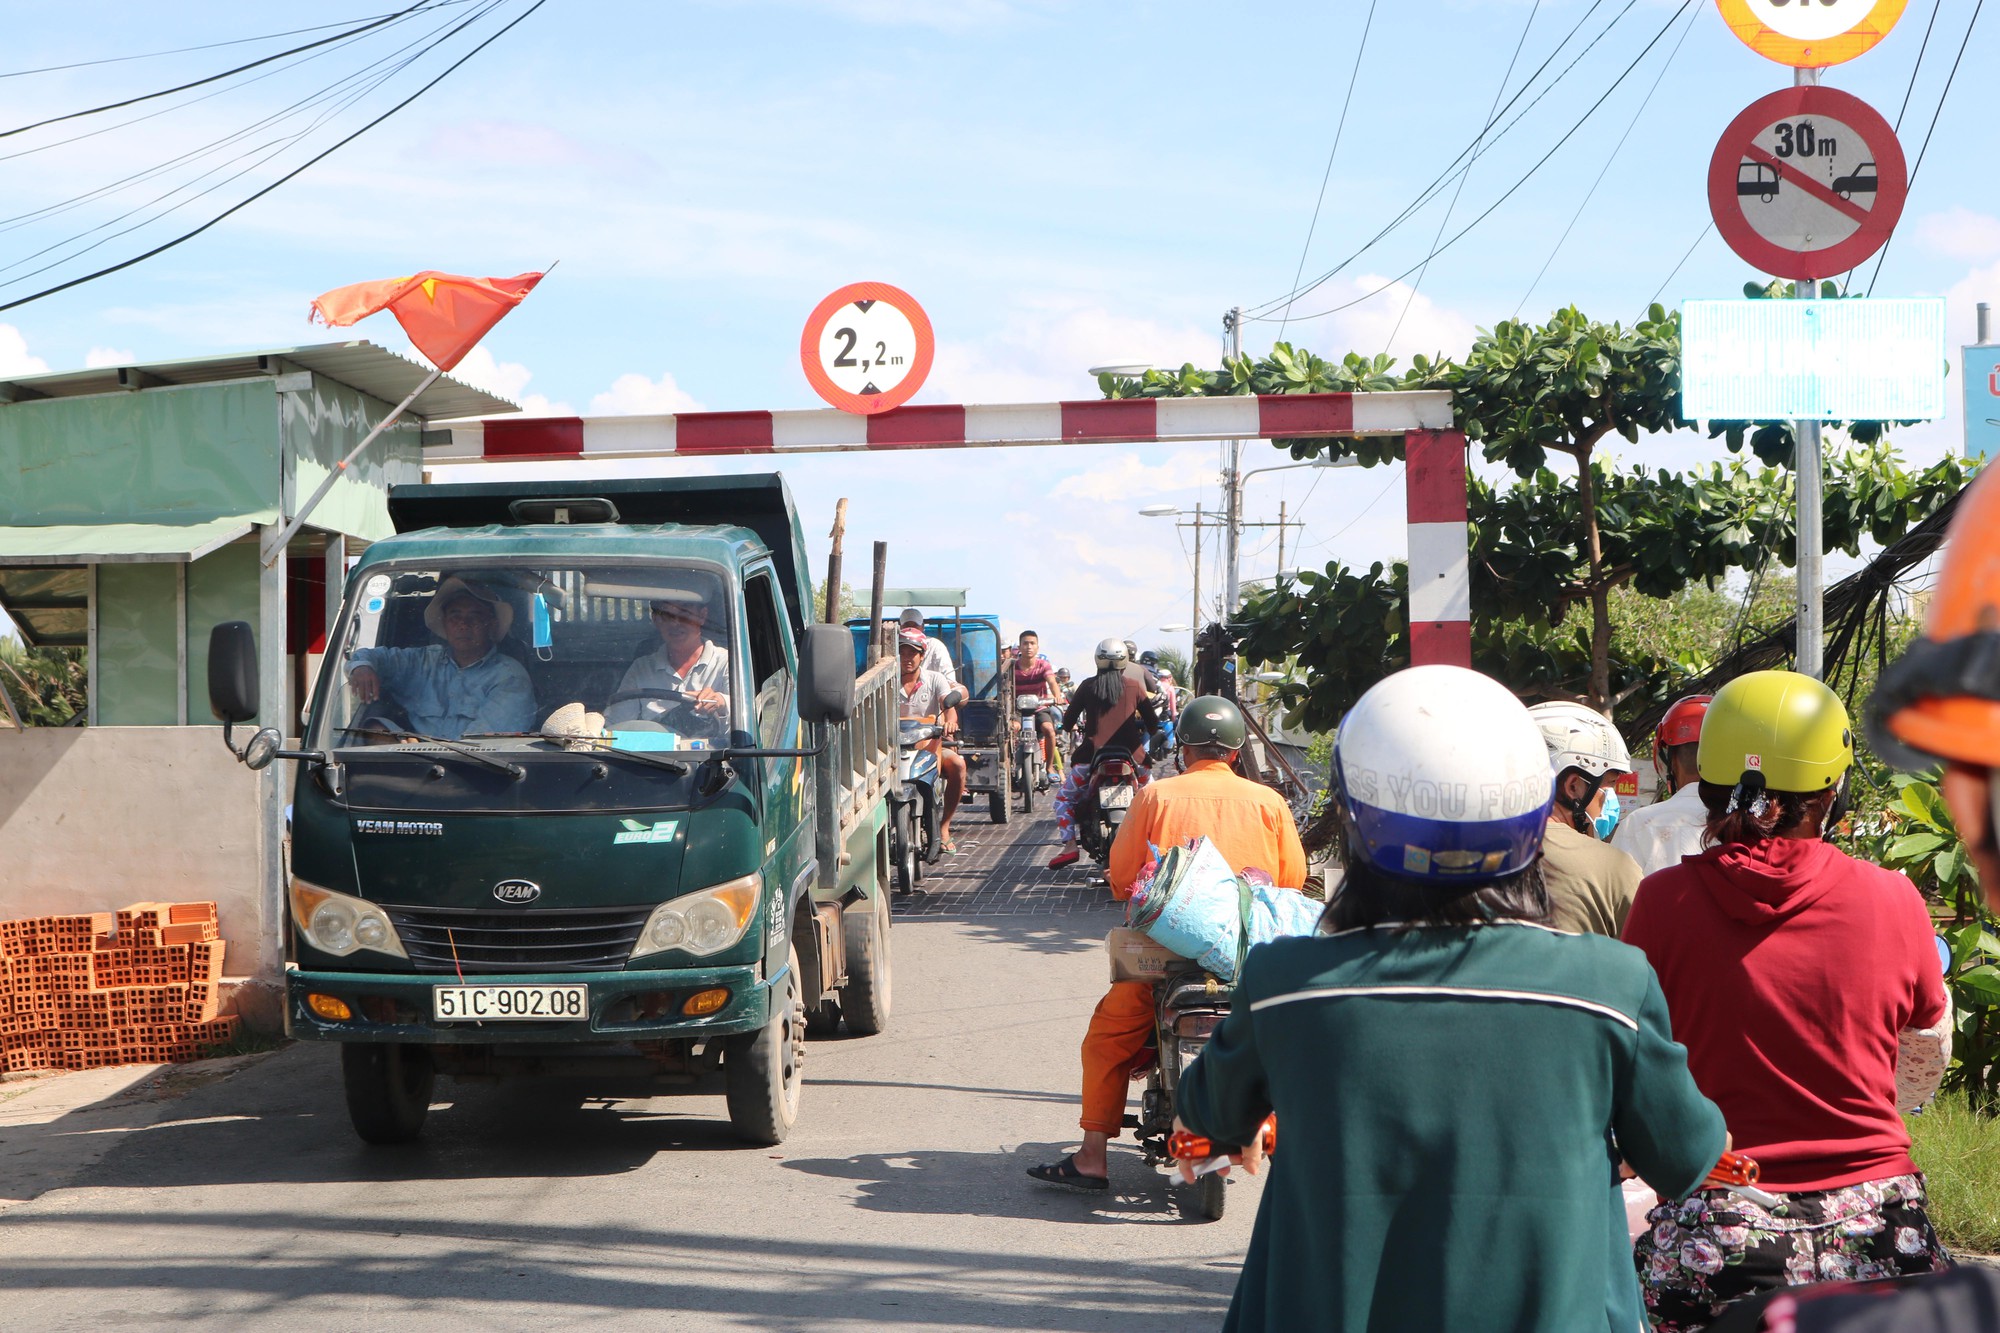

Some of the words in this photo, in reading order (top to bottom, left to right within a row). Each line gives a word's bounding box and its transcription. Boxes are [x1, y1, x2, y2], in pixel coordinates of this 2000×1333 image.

[1341, 761, 1379, 808] SS
[1387, 774, 1468, 820] YOU
[357, 819, 395, 834] VEAM
[397, 821, 443, 836] MOTOR
[617, 831, 651, 843] EURO
[498, 885, 534, 898] VEAM
[440, 990, 581, 1016] 51C-902.08
